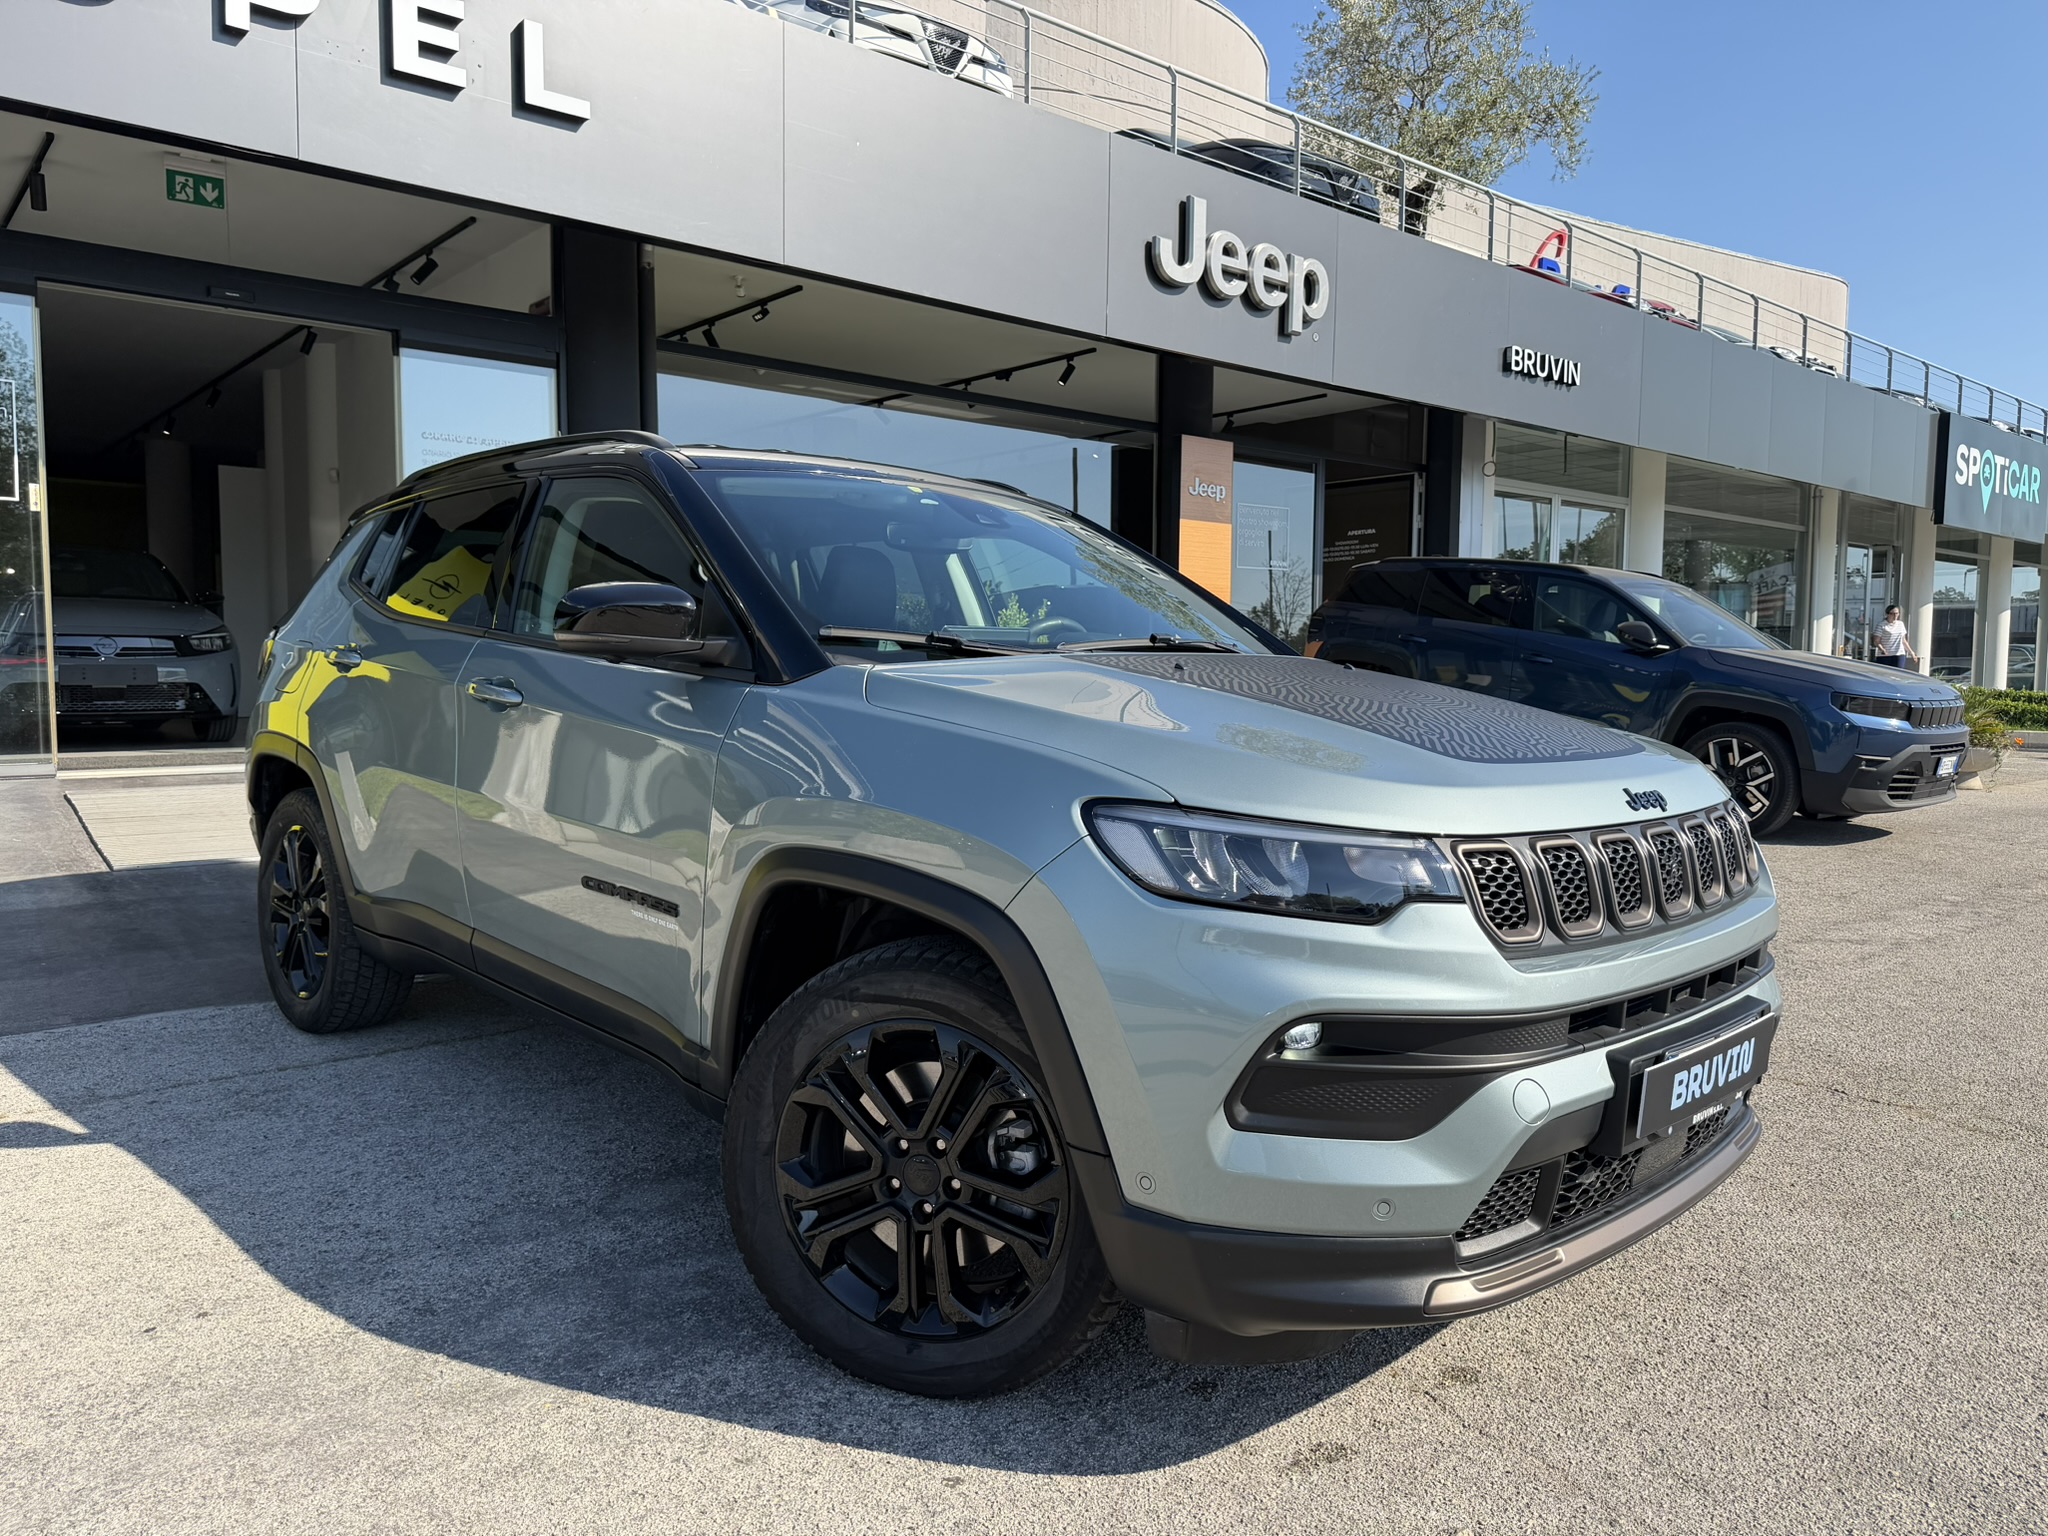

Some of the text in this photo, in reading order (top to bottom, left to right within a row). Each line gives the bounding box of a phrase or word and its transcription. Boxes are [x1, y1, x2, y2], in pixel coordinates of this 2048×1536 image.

[225, 0, 591, 120] EL
[1151, 194, 1330, 335] Jeep
[1510, 344, 1581, 387] BRUVIN
[1188, 477, 1226, 502] Jeep
[1347, 528, 1376, 537] APERTURA
[1622, 787, 1668, 813] Jeep
[581, 875, 680, 918] COMPASS
[1670, 1037, 1755, 1111] BRUVIN
